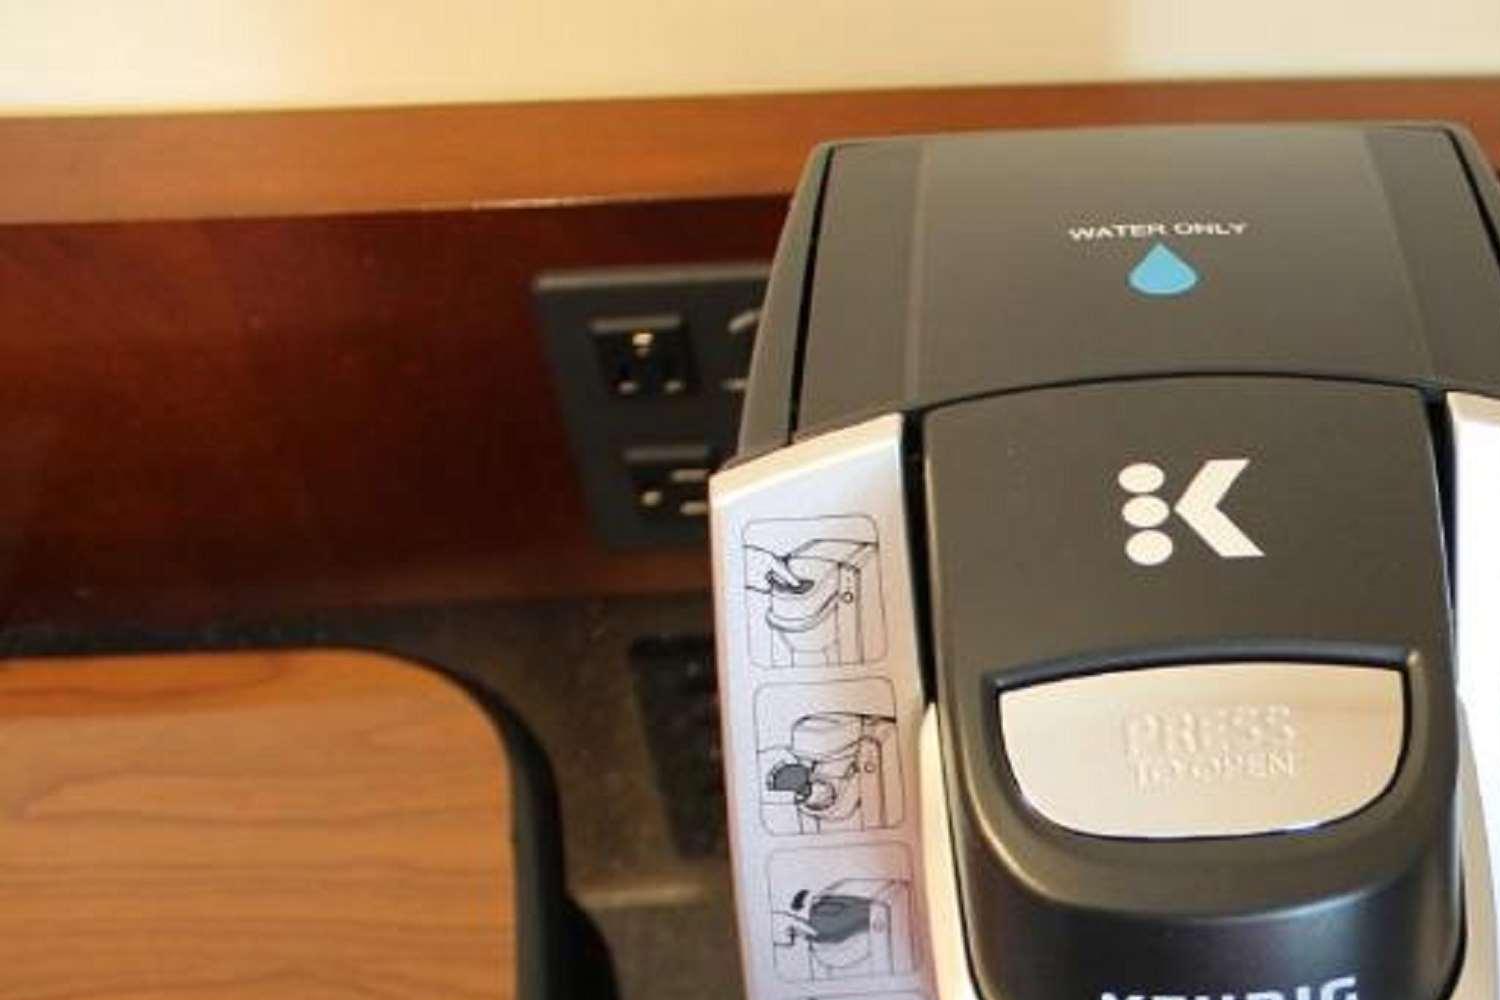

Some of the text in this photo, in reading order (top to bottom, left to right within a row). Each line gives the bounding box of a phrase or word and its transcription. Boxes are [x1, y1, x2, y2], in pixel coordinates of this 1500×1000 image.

[1068, 221, 1248, 242] WATER ONLY
[1121, 702, 1296, 757] PRESS
